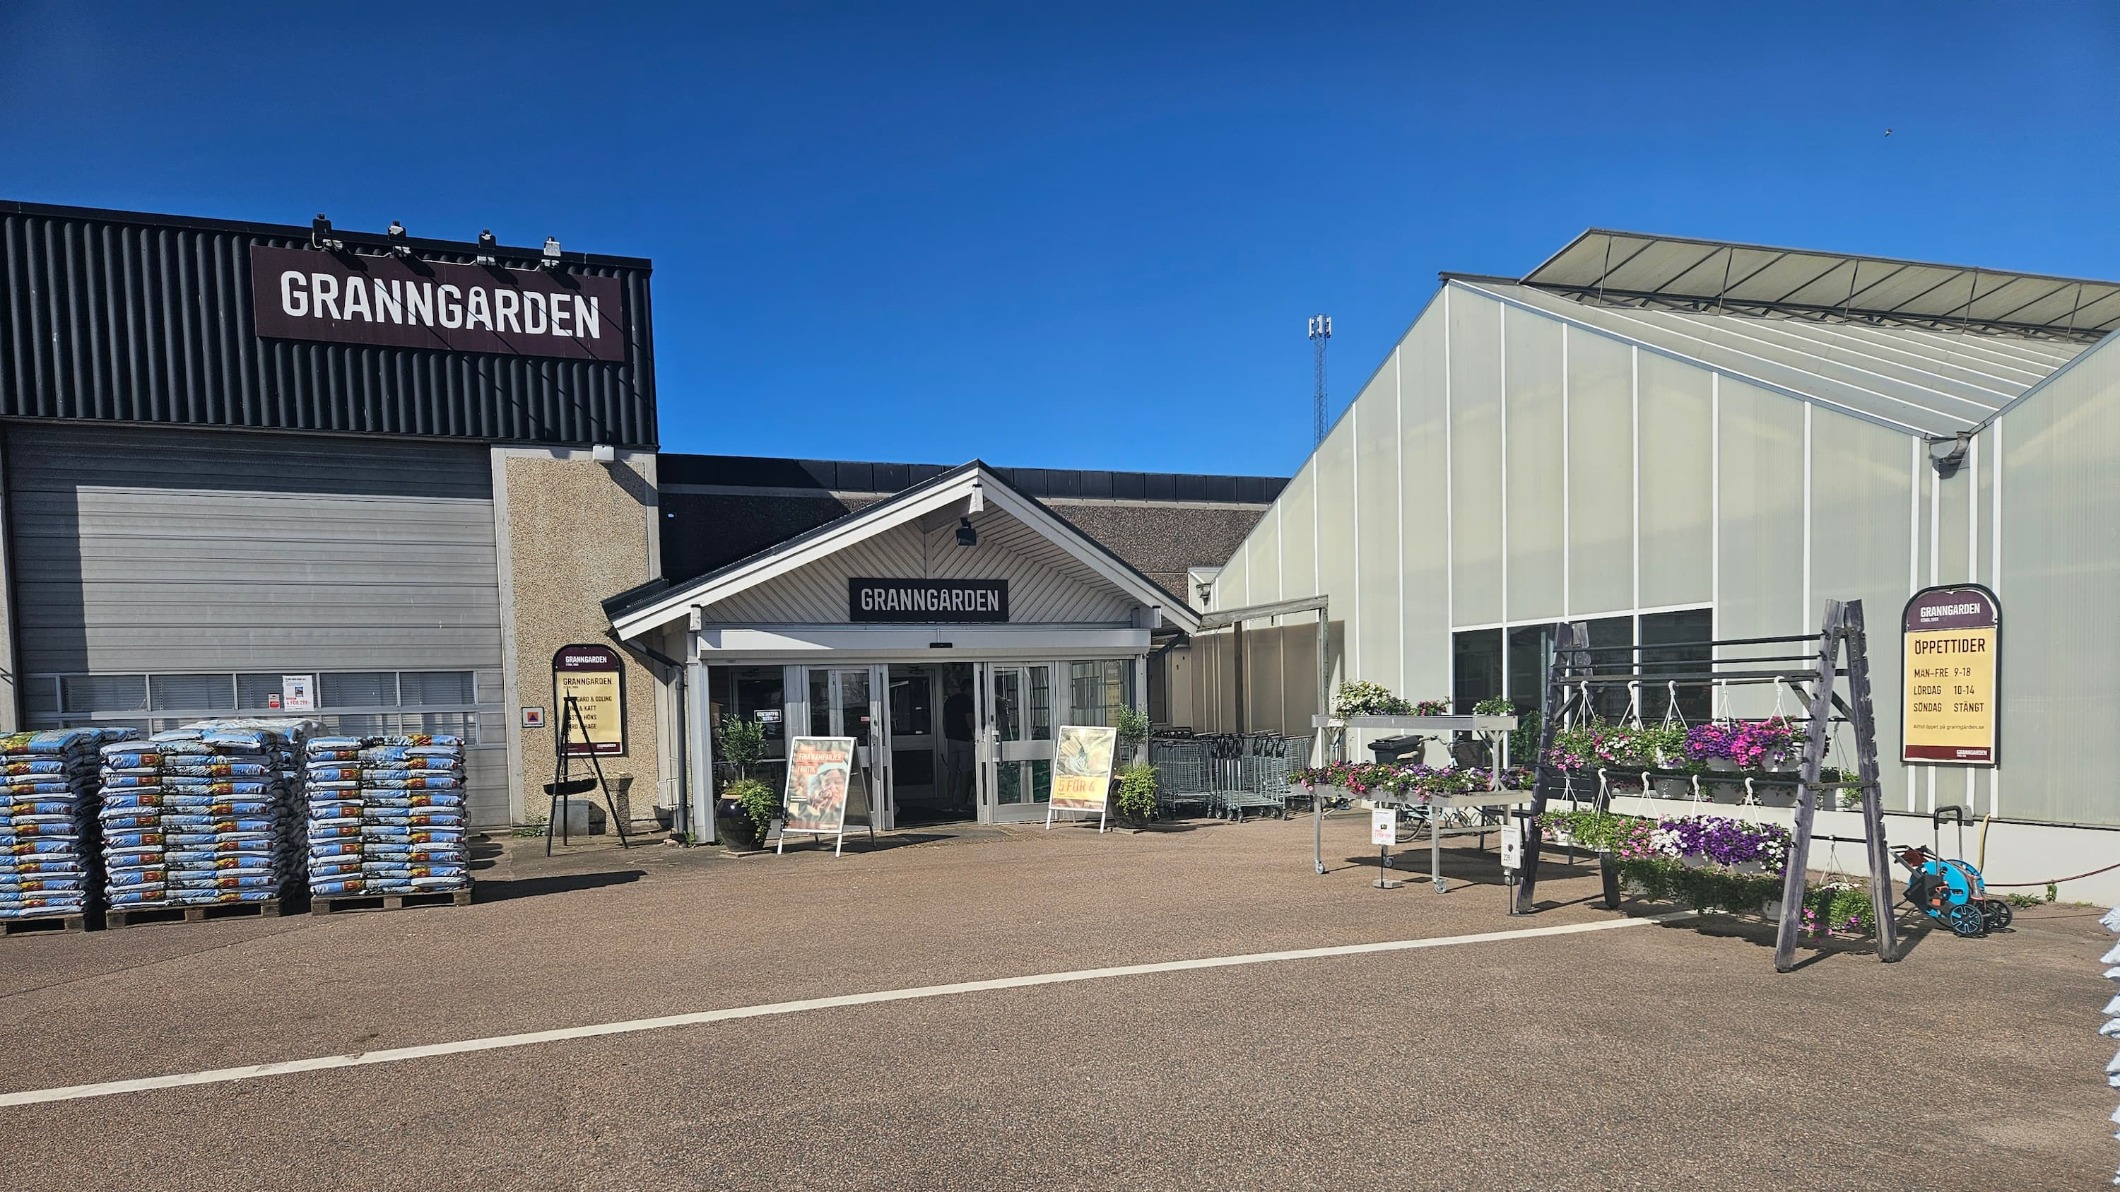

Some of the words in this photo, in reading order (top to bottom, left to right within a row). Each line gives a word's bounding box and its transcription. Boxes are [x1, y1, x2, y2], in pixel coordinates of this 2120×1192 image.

[1914, 638, 1985, 655] ÖPPETTIDER
[1954, 667, 1971, 677] 9-18
[1953, 685, 1975, 695] 10-14
